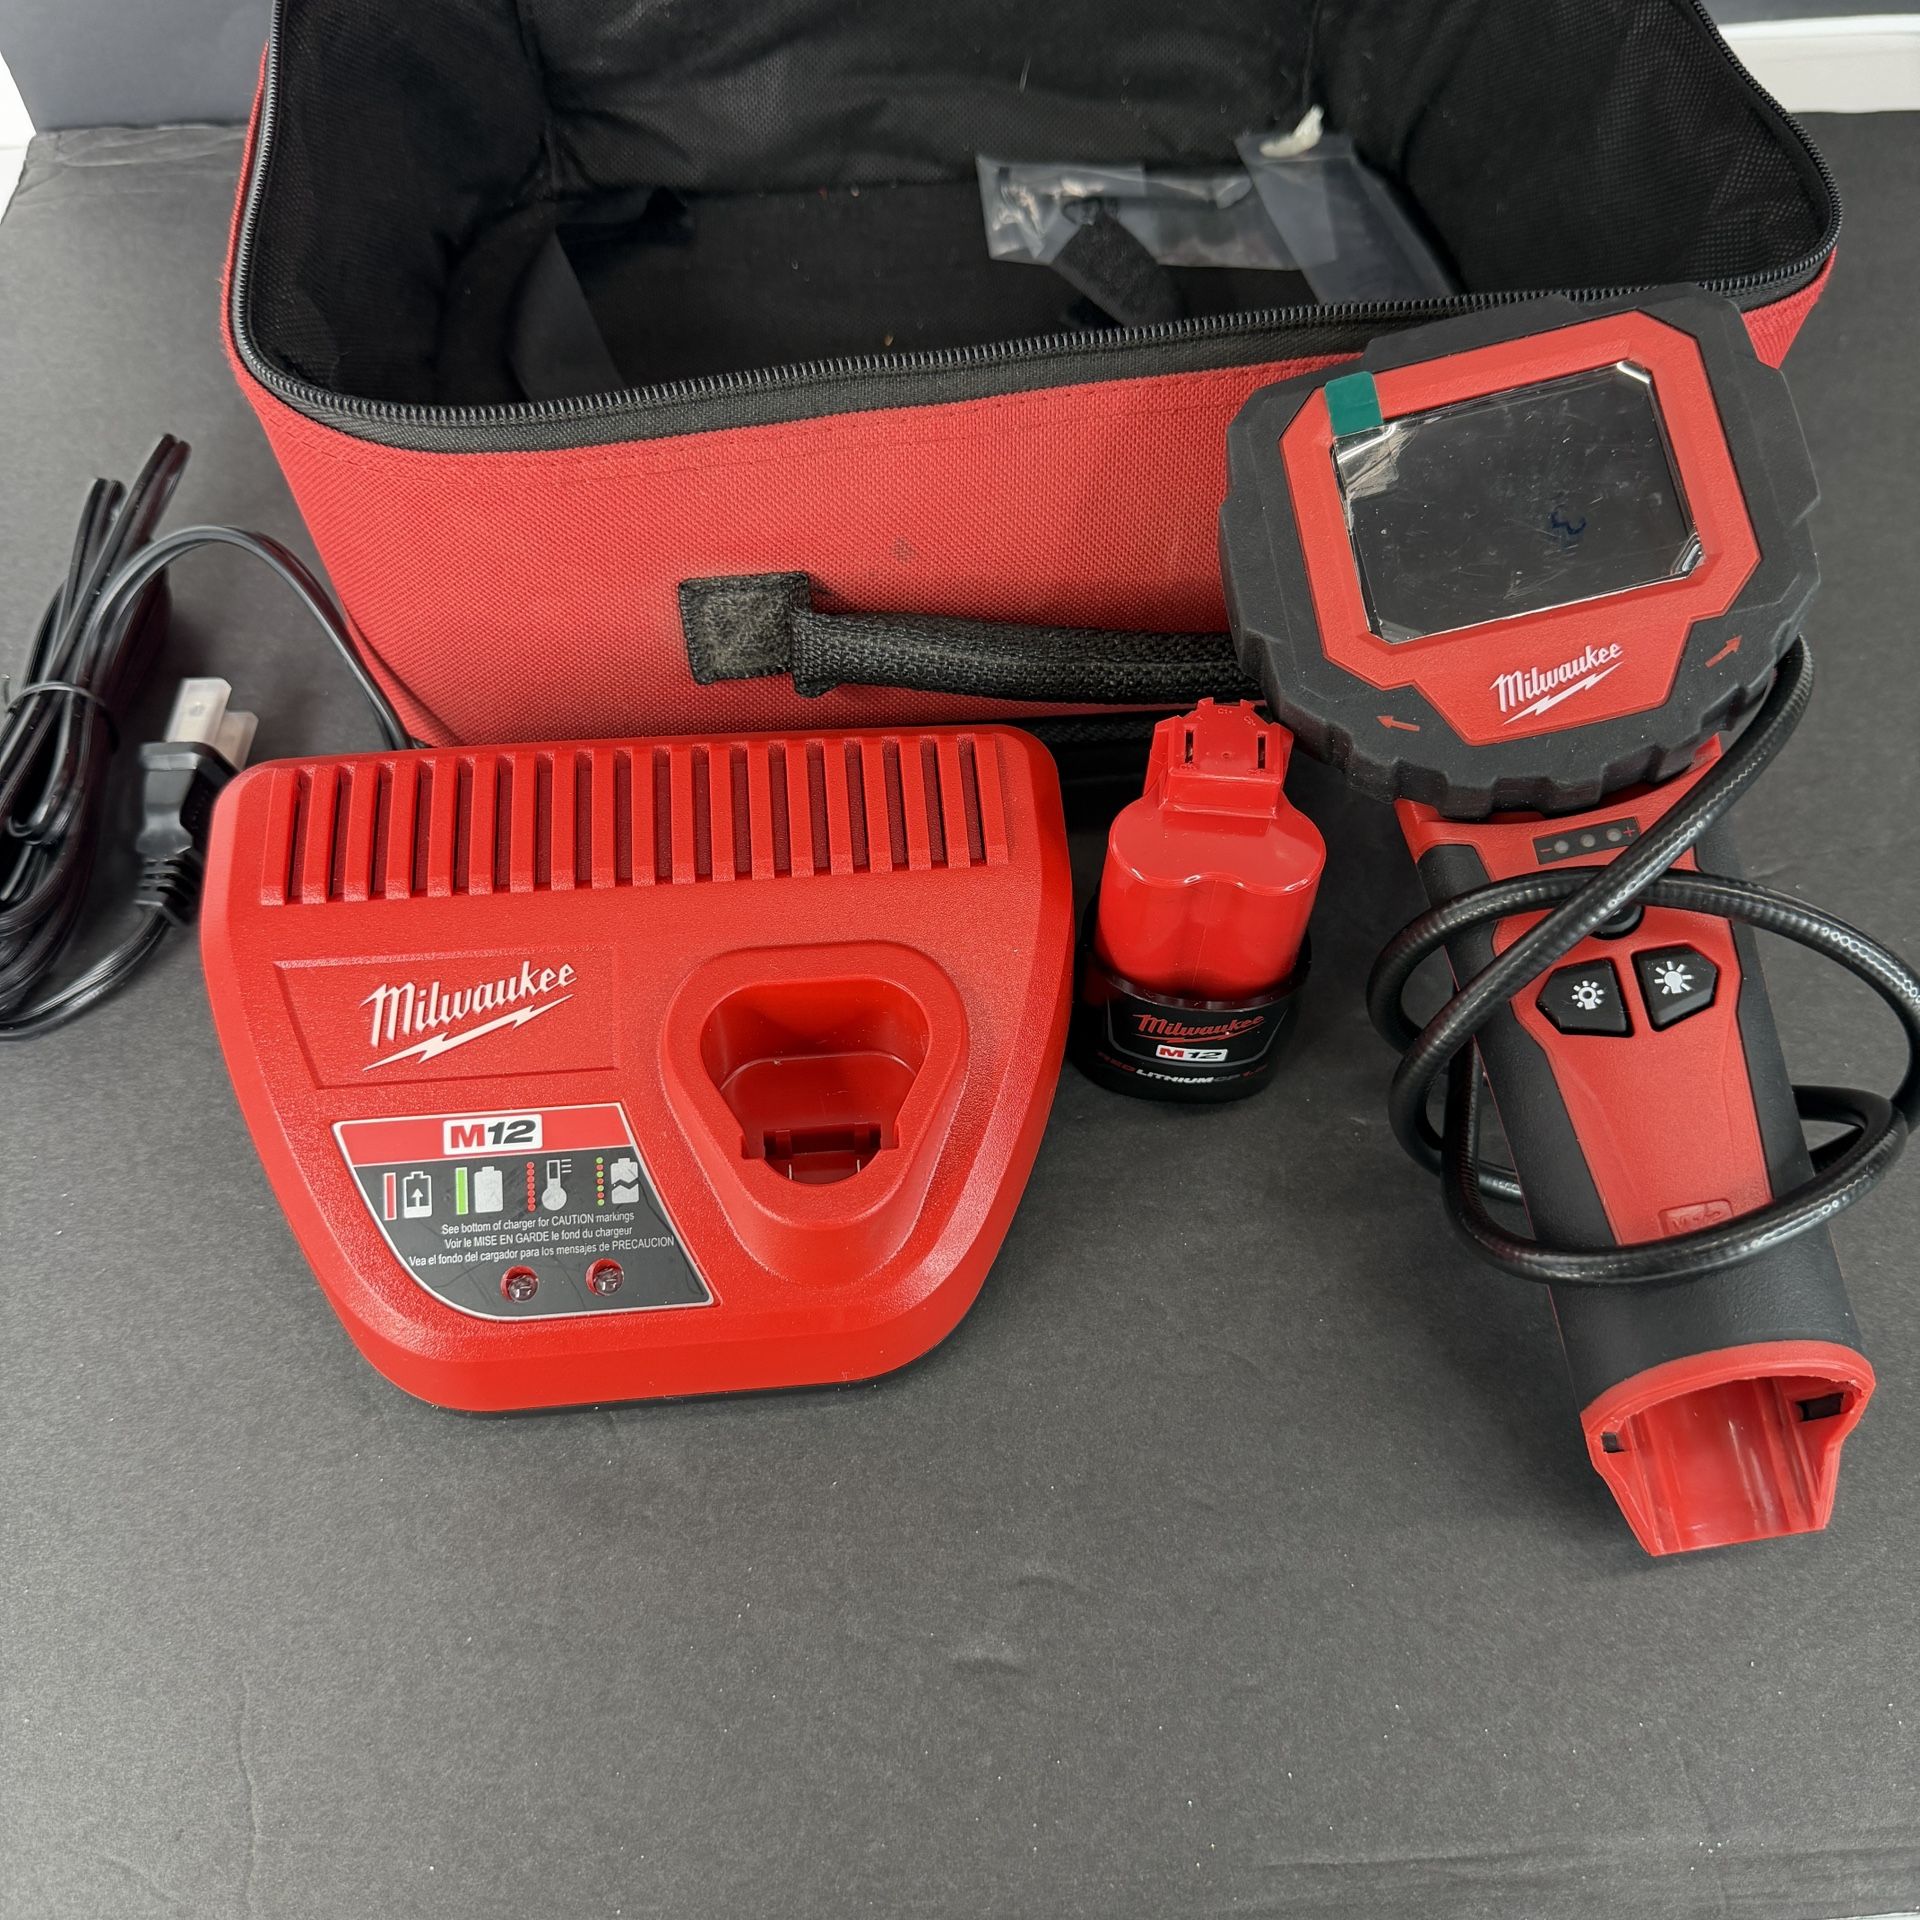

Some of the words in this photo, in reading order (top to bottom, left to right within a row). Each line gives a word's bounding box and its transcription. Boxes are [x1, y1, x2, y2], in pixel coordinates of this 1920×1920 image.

[1489, 642, 1624, 713] Milwaukee
[359, 960, 577, 1049] Milwaukee
[1132, 1014, 1265, 1037] Milwaukee
[1158, 1046, 1223, 1060] M12
[450, 1119, 537, 1150] M12
[441, 1223, 460, 1235] See
[461, 1221, 491, 1234] bottom
[492, 1219, 502, 1231] of
[503, 1219, 536, 1231] charger
[538, 1216, 550, 1228] for
[551, 1213, 594, 1226] CAUTION
[595, 1211, 635, 1224] markings
[409, 1255, 427, 1267] Vea
[428, 1254, 437, 1266] el
[438, 1253, 463, 1265] fondo
[465, 1251, 479, 1263] del
[480, 1249, 518, 1263] cargador
[519, 1247, 540, 1260] para
[541, 1245, 555, 1257] los
[556, 1243, 597, 1256] mensajes
[598, 1241, 610, 1253] de
[611, 1236, 675, 1252] PRECAUCION
[444, 1238, 462, 1250] Voir
[463, 1236, 472, 1248] le
[473, 1235, 498, 1248] MISE
[499, 1234, 514, 1246] EN
[515, 1231, 550, 1244] GARDE
[551, 1230, 560, 1242] le
[561, 1229, 580, 1240] fond
[582, 1228, 593, 1239] du
[595, 1227, 633, 1239] chargeur
